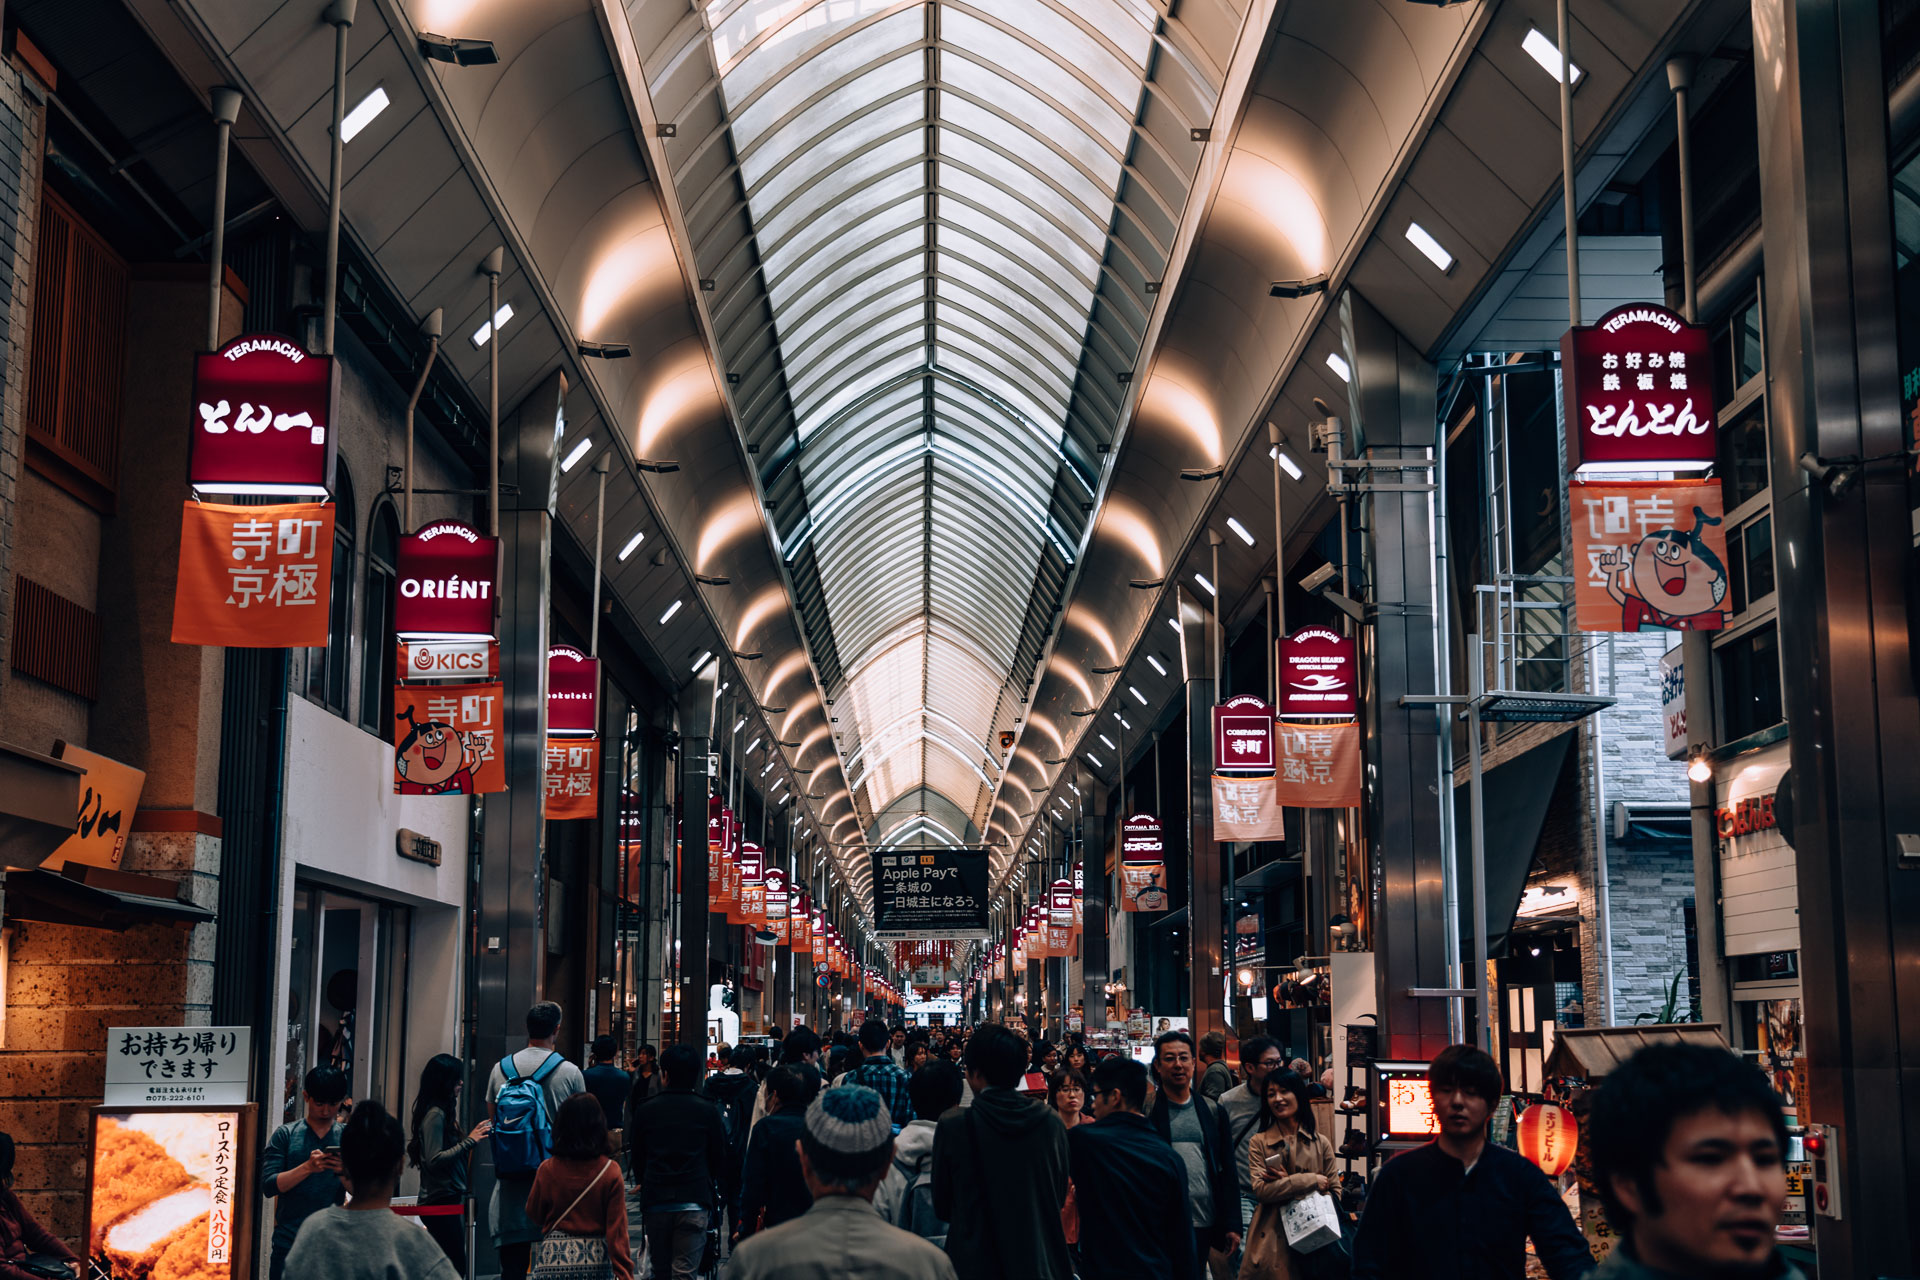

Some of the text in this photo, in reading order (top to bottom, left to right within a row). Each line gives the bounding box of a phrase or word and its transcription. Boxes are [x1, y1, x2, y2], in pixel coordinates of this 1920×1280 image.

[1603, 310, 1682, 334] TERAMACHI
[223, 340, 304, 363] TERAMACHI
[1602, 351, 1686, 370] お好み焼
[1602, 373, 1688, 391] 鉄板焼
[1586, 398, 1710, 437] とんとん
[232, 518, 323, 562] 寺町
[419, 524, 479, 543] TERAMACHI
[225, 564, 319, 608] 京極
[400, 575, 491, 600] ORIÉNT
[1294, 630, 1340, 644] TERAMACHI
[436, 652, 484, 670] KICS
[1289, 656, 1320, 664] DRAGON
[1227, 697, 1265, 710] TERAMACHI
[1231, 739, 1263, 755] 寺町
[882, 867, 958, 881] Apple Payで
[883, 882, 932, 894] 二条城の
[883, 896, 980, 909] 一日城主になろう。
[119, 1031, 237, 1057] お持ち帰り
[140, 1058, 218, 1079] できます
[213, 1121, 231, 1205] ロースかつ定食
